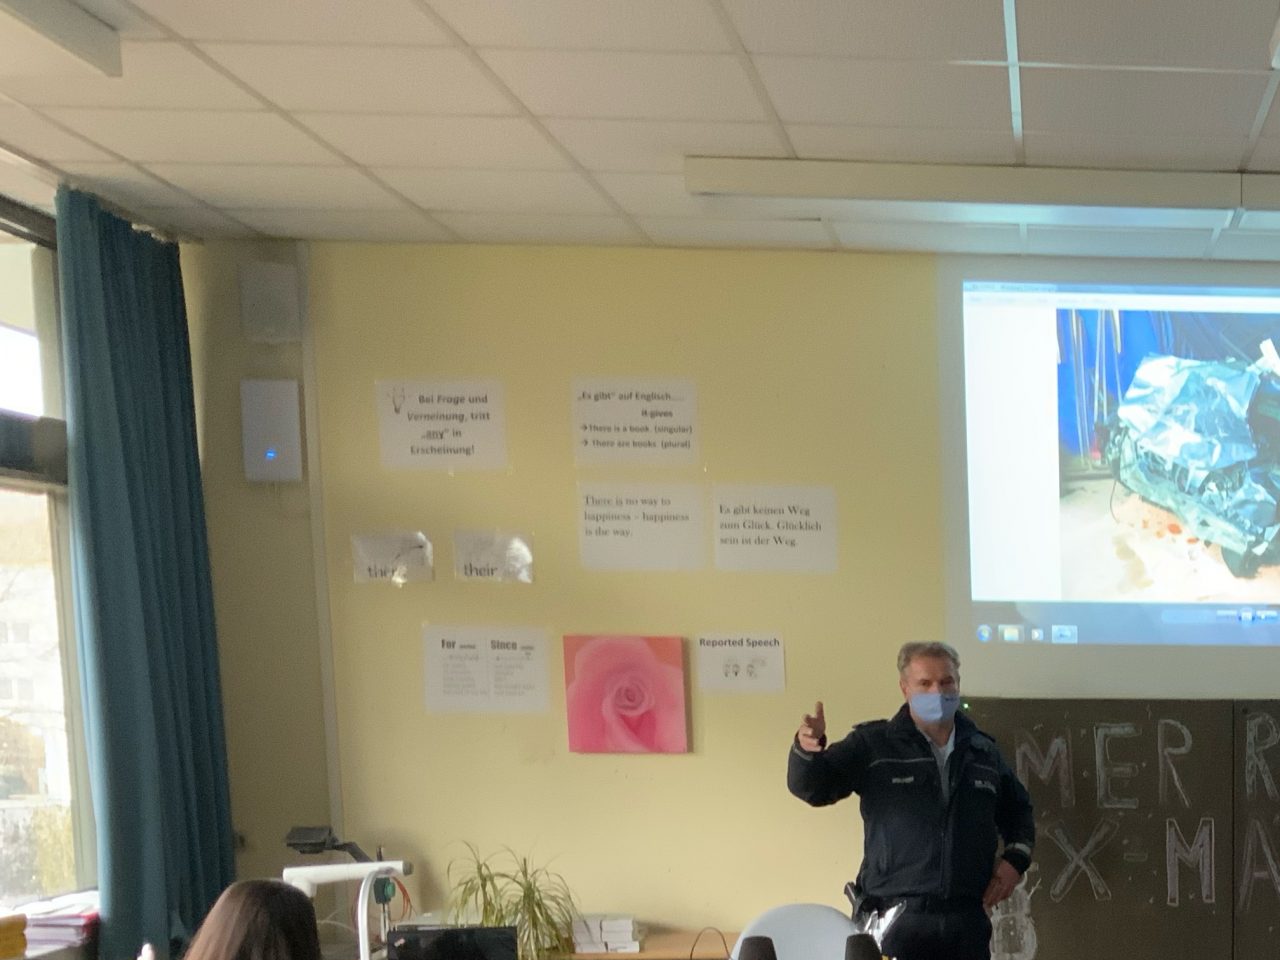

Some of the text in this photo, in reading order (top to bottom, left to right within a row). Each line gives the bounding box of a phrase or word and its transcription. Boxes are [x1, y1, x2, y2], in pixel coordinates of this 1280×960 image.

[468, 394, 488, 404] und
[452, 429, 462, 438] in
[585, 495, 614, 507] There
[626, 497, 638, 506] no
[640, 497, 657, 508] way
[660, 496, 671, 506] to
[733, 504, 751, 516] gibt
[753, 504, 785, 515] keinen
[787, 504, 811, 517] Weg
[584, 511, 690, 523] happiness happiness
[719, 521, 740, 531] zum
[585, 527, 593, 537] is
[595, 527, 611, 537] the
[719, 536, 739, 545] sein
[741, 536, 752, 545] ist
[754, 536, 770, 546] der
[463, 562, 498, 578] their
[699, 637, 780, 649] Reported Speech
